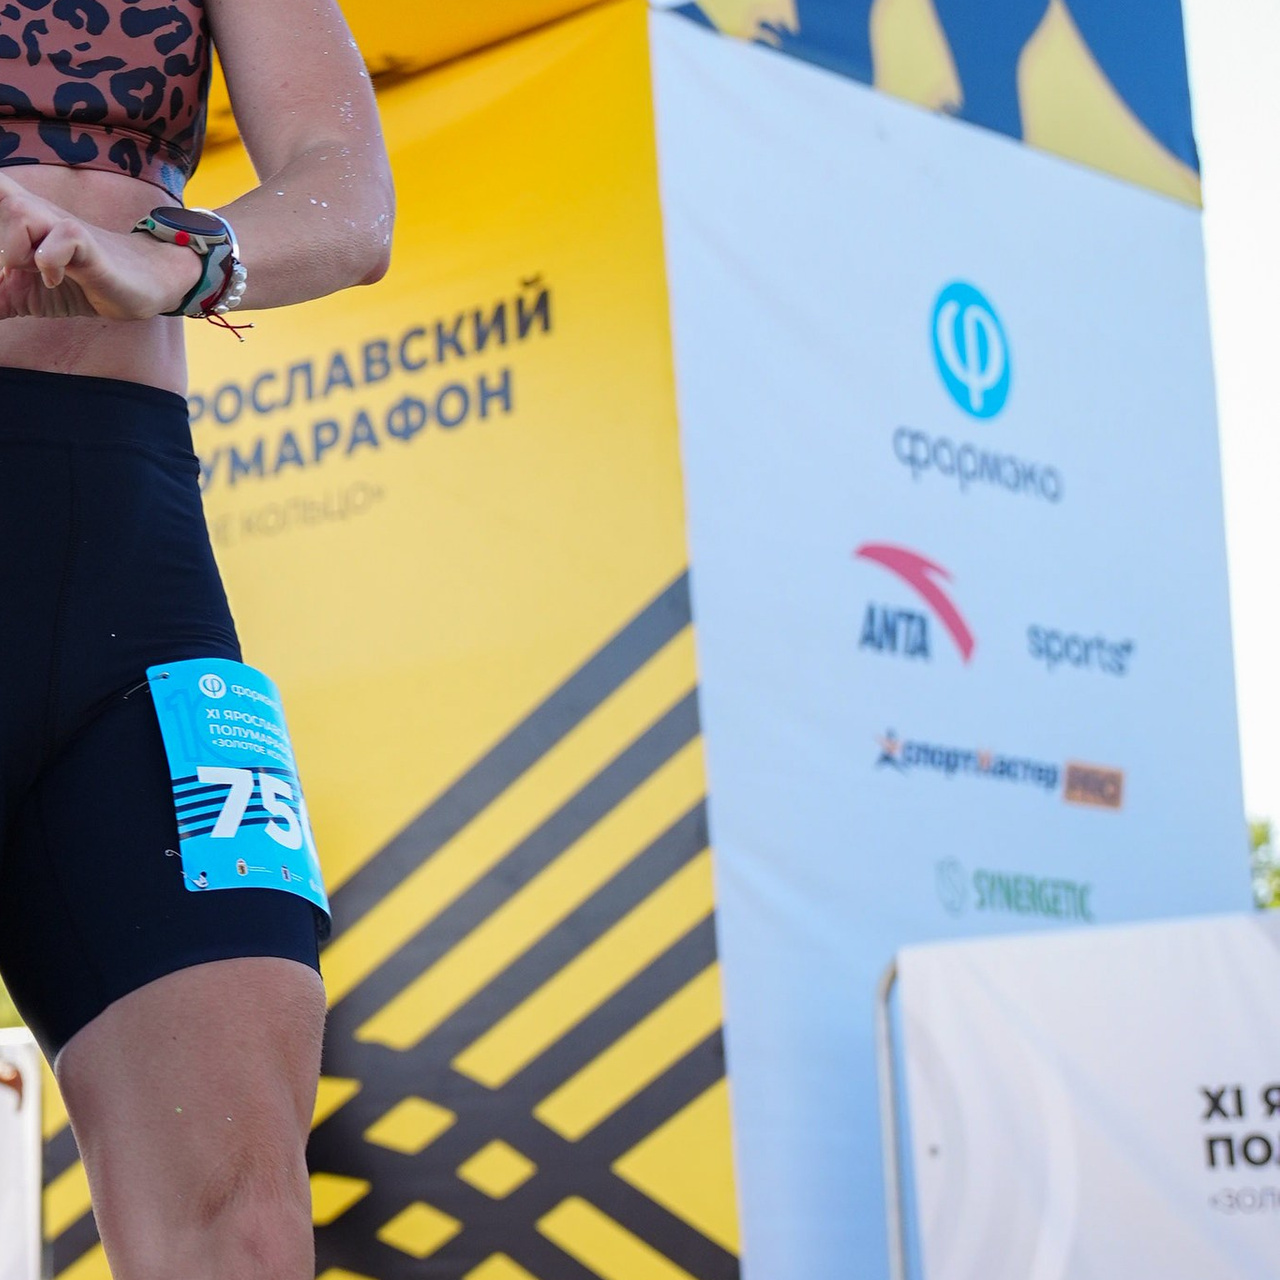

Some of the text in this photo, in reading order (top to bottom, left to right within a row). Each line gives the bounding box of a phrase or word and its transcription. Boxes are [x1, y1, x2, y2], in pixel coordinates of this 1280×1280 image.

[859, 601, 932, 662] ANTA
[197, 766, 320, 868] 75
[973, 868, 1094, 923] SYNERGETIC
[1206, 1133, 1280, 1167] ПО
